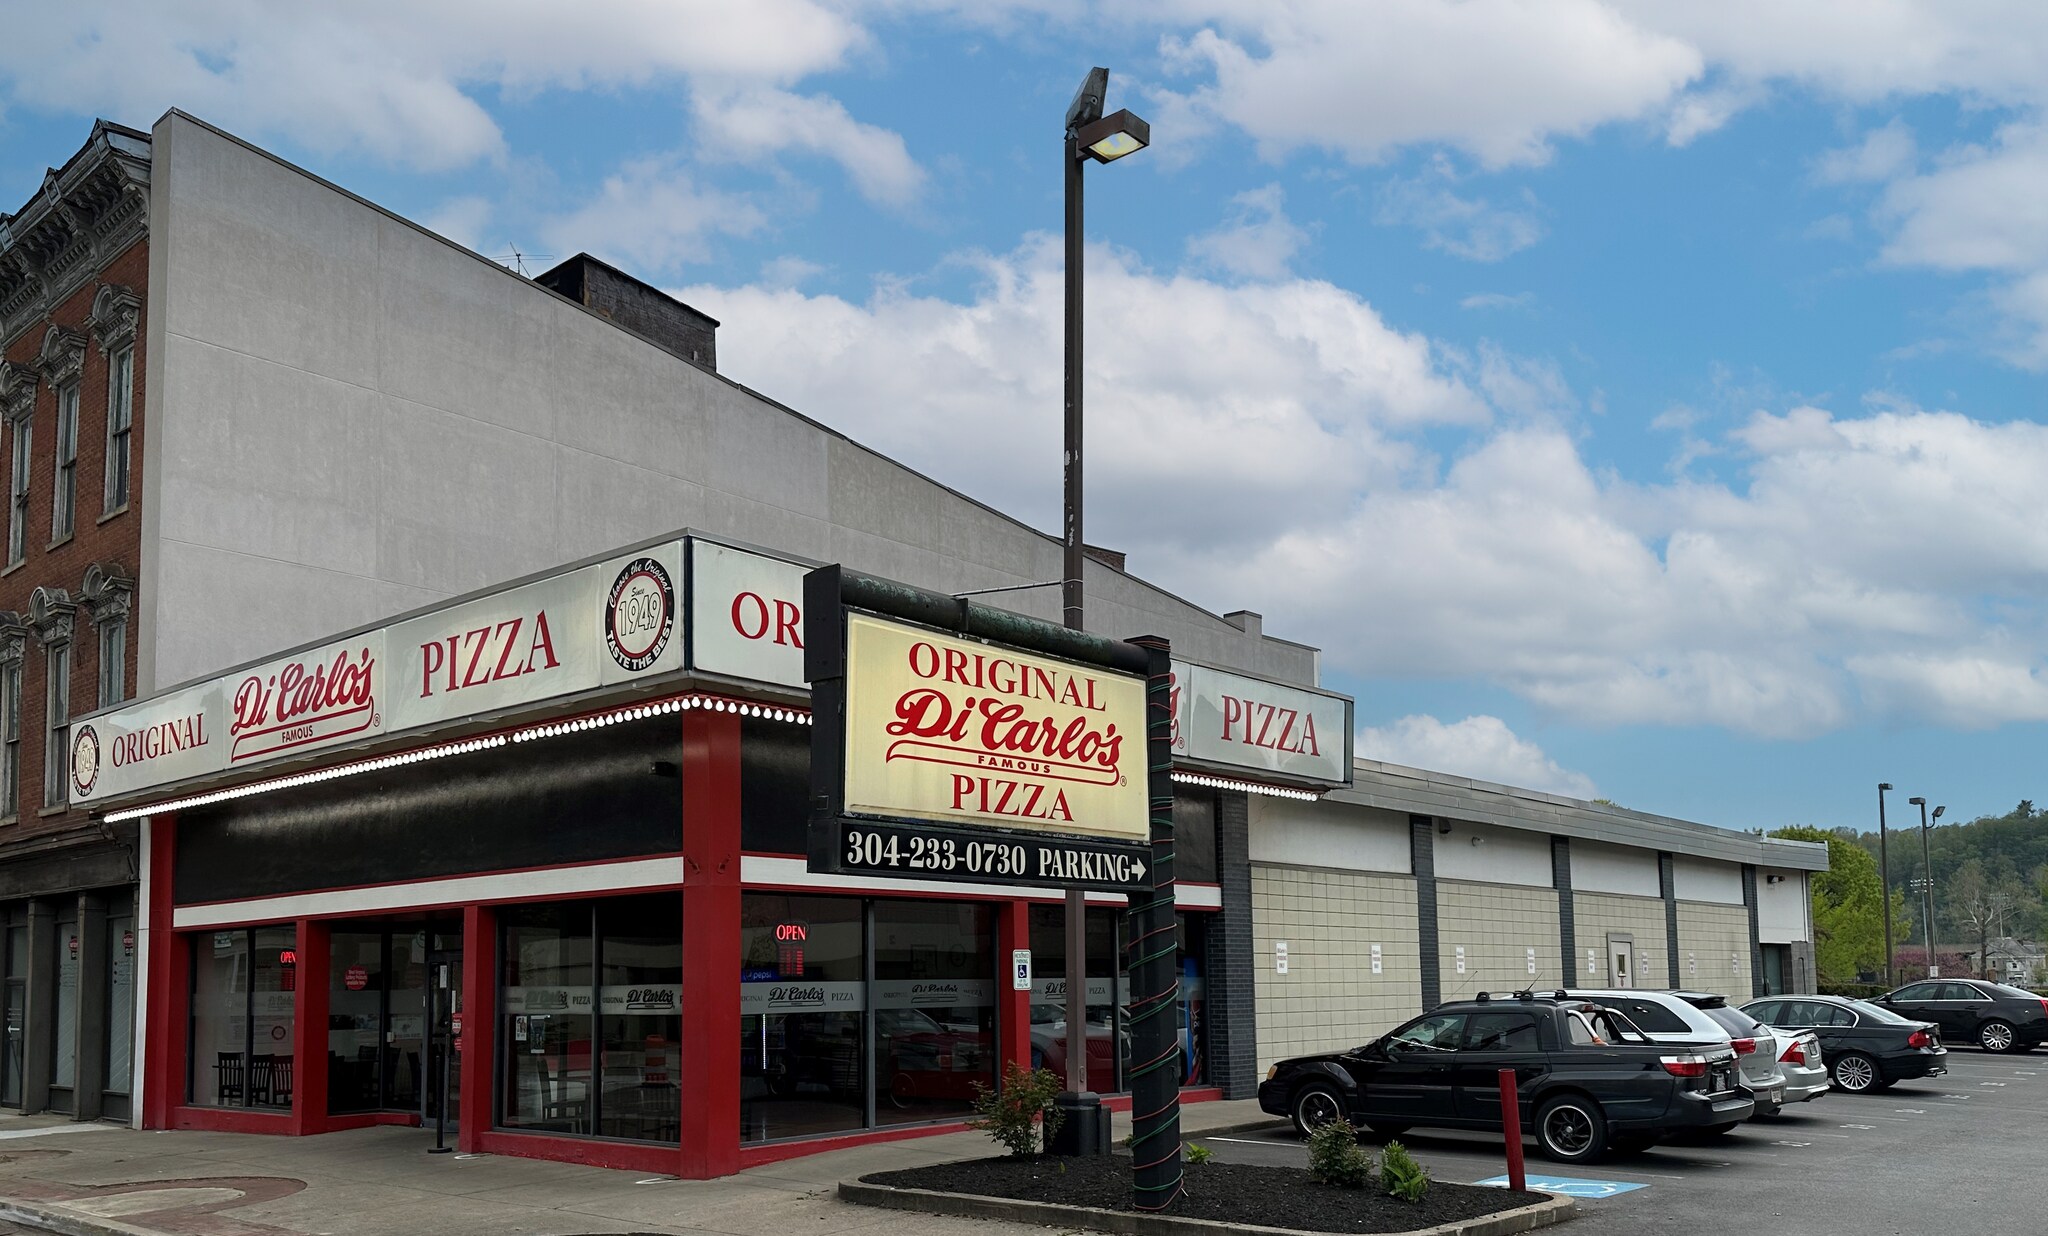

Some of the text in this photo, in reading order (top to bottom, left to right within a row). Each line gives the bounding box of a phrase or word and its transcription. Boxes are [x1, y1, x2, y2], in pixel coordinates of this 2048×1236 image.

[608, 559, 672, 609] Choose the Original
[631, 587, 645, 597] Since
[619, 592, 661, 636] 1949
[420, 609, 561, 698] PIZZA
[606, 616, 673, 670] TASTE THE BEST
[908, 642, 1107, 712] ORIGINAL
[112, 713, 209, 767] ORIGINAL
[282, 725, 314, 743] FAMOUS
[1221, 694, 1321, 757] PIZZA
[977, 755, 1052, 774] FAMOUS
[949, 773, 1075, 822] PIZZA
[847, 831, 1132, 882] 304-233-0730 PARKING
[776, 924, 806, 940] OPEN
[753, 971, 772, 980] pepsi
[831, 992, 854, 1001] PIZZA
[1089, 986, 1106, 995] PIZZA
[572, 995, 591, 1005] PIZZA
